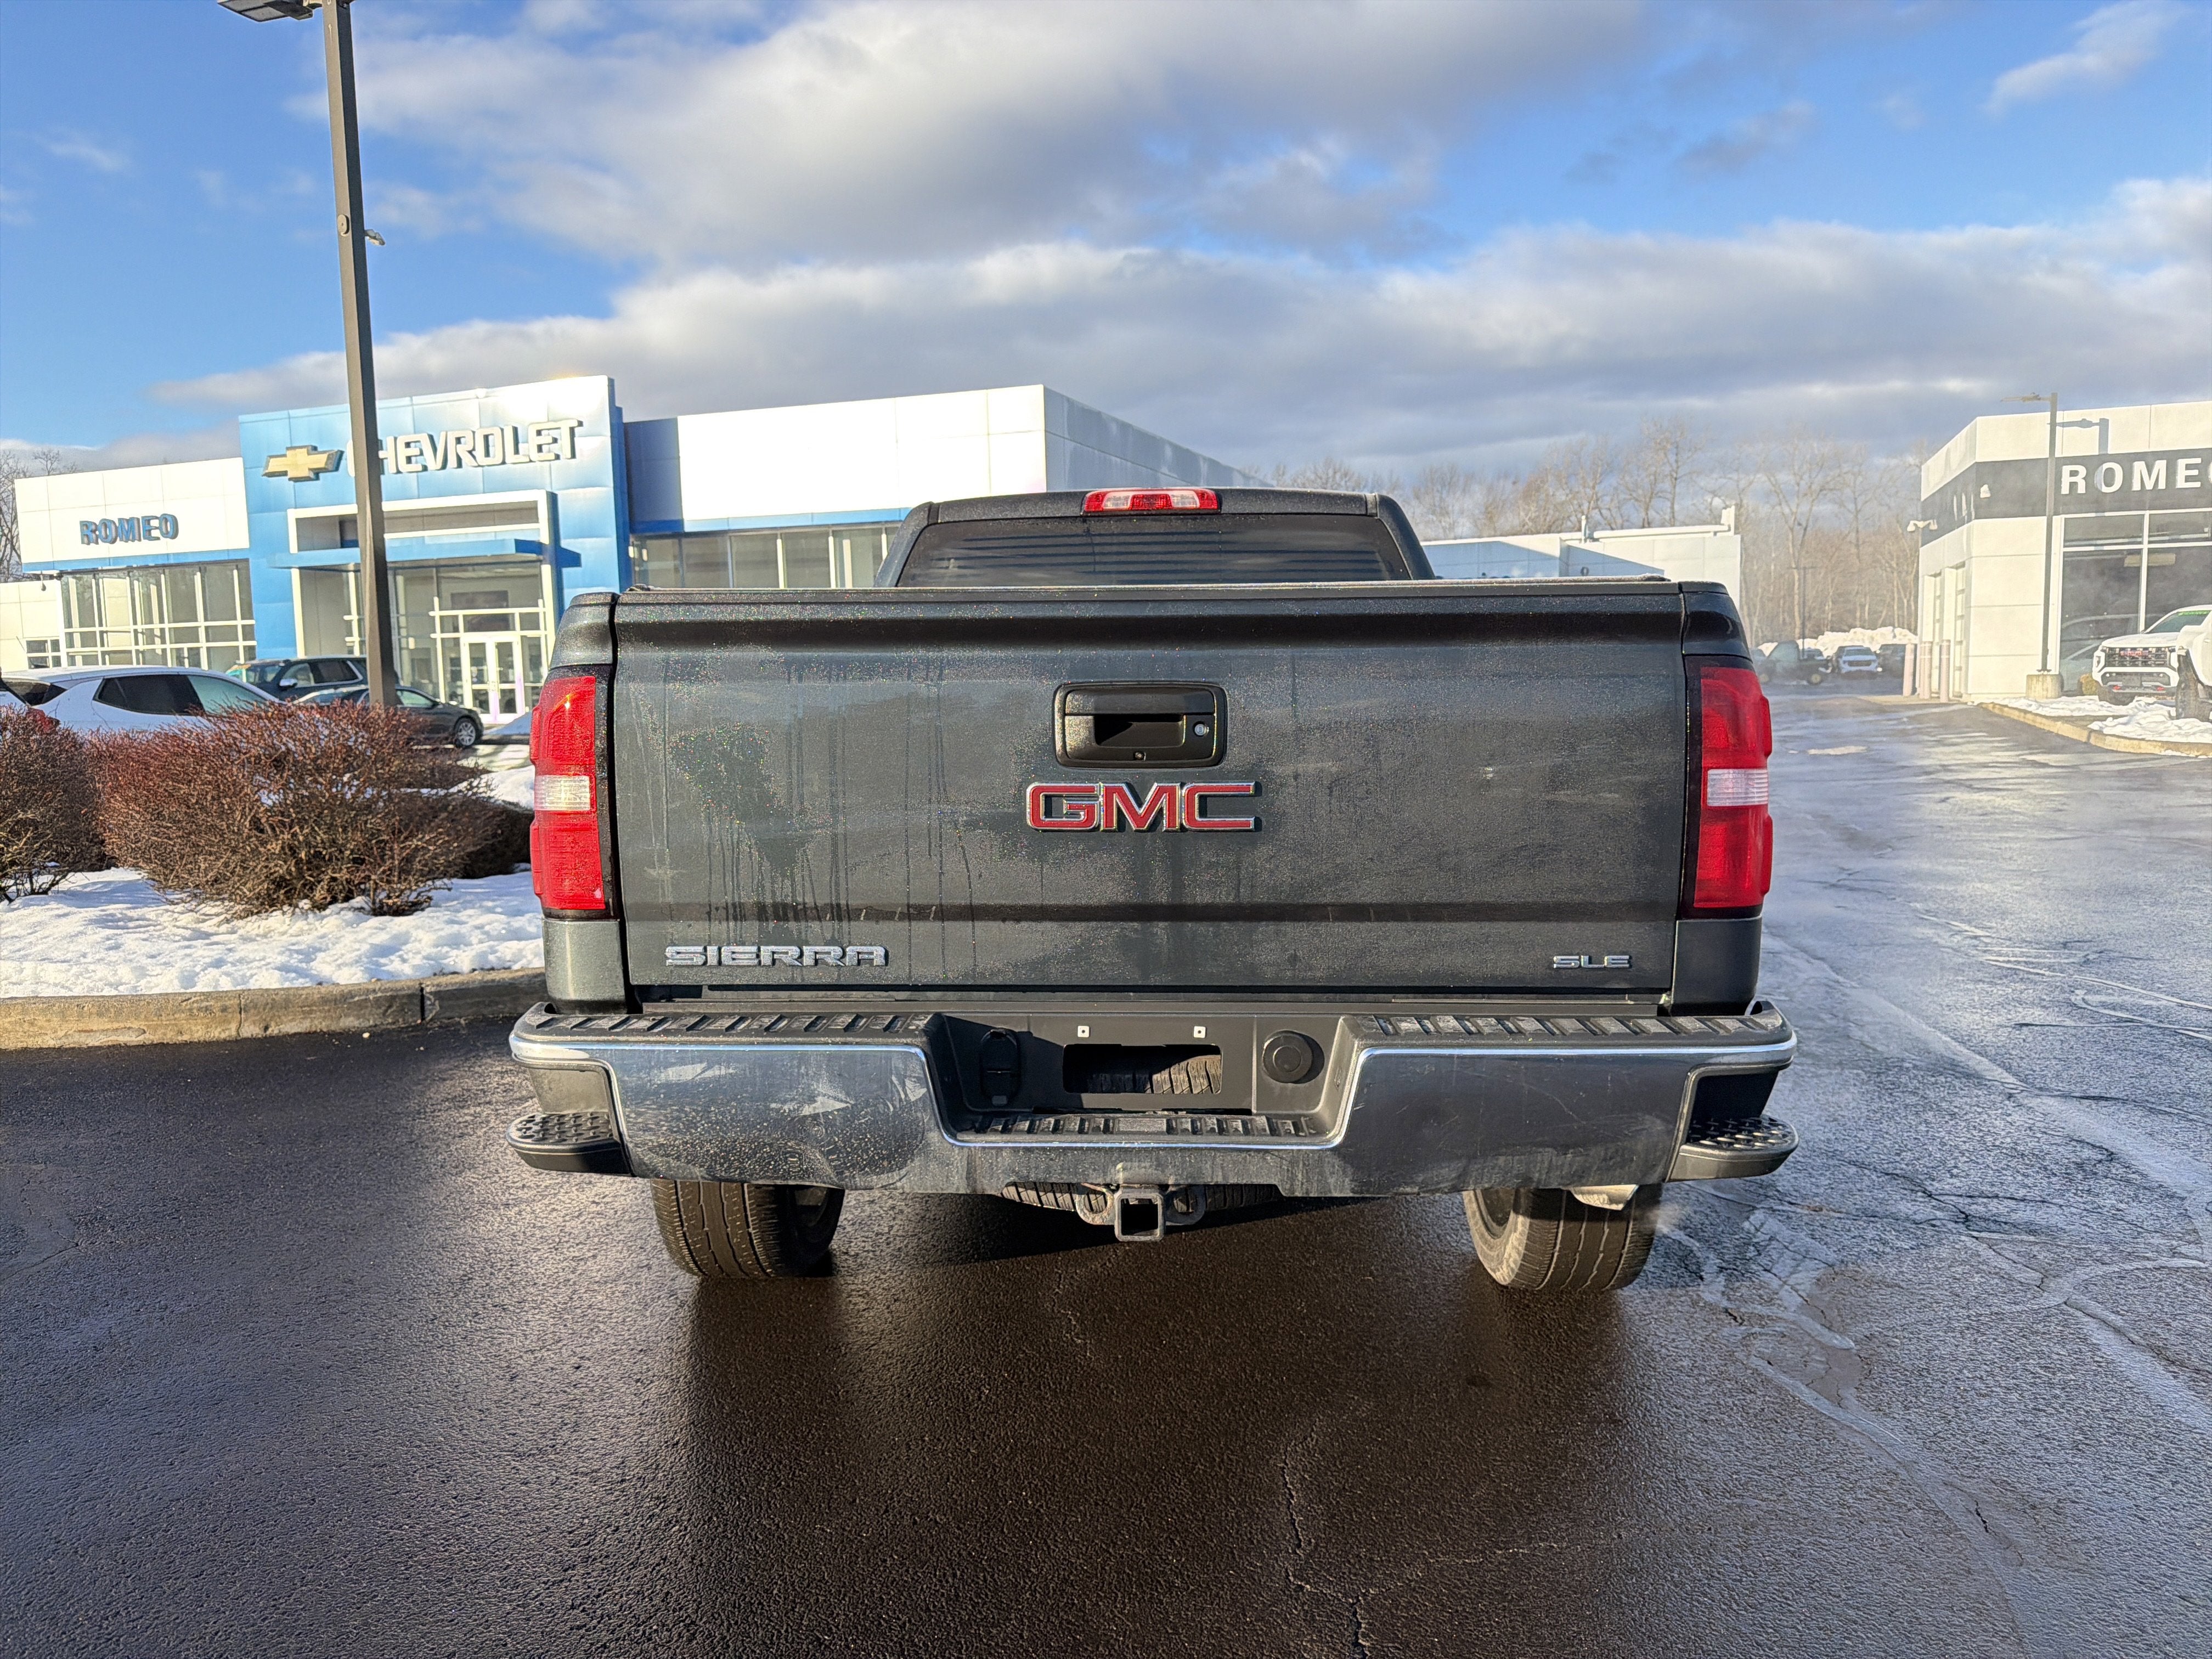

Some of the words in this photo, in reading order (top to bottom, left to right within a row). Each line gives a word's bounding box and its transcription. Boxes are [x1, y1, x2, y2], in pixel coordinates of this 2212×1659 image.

[2061, 458, 2212, 494] ROME
[80, 513, 179, 545] ROMEO
[1026, 782, 1256, 831] GMC
[665, 946, 887, 966] SIERRA
[1553, 955, 1629, 968] SLE
